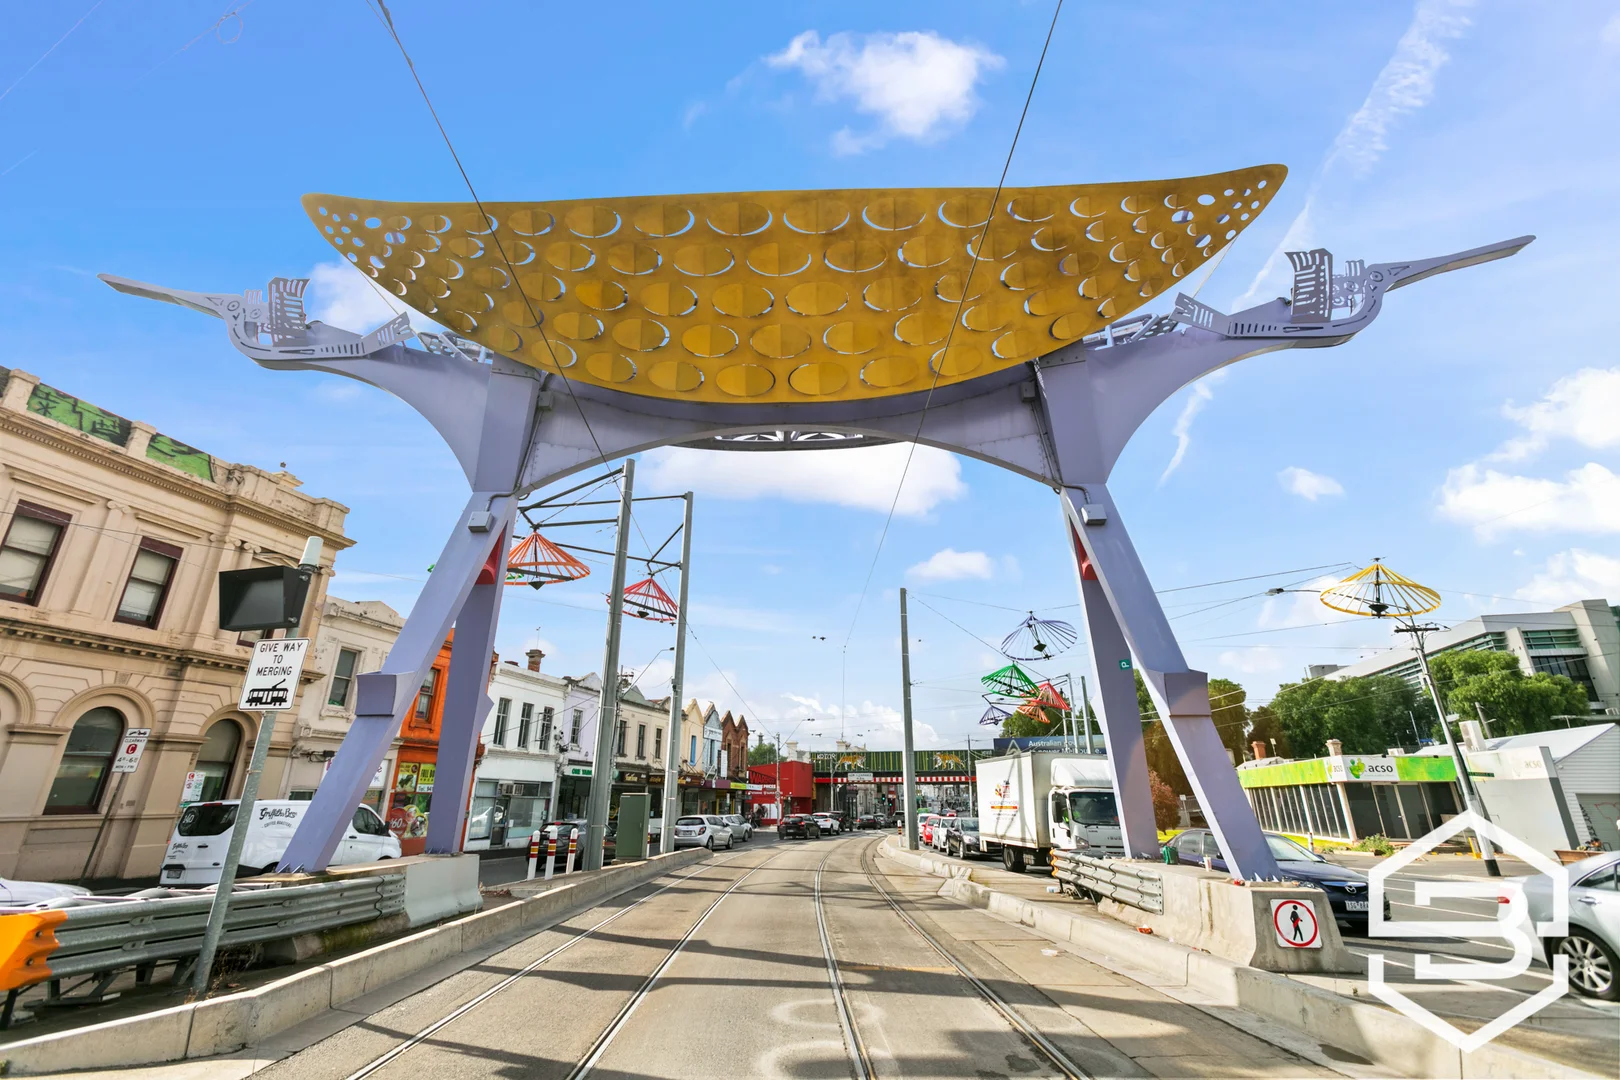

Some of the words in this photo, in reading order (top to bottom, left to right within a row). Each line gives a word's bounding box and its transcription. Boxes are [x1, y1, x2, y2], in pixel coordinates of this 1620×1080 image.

[260, 643, 279, 653] GIVE
[283, 642, 303, 652] WAY
[273, 655, 283, 664] TO
[256, 666, 292, 676] MERGING
[1368, 765, 1394, 773] acso
[1524, 761, 1542, 769] acso
